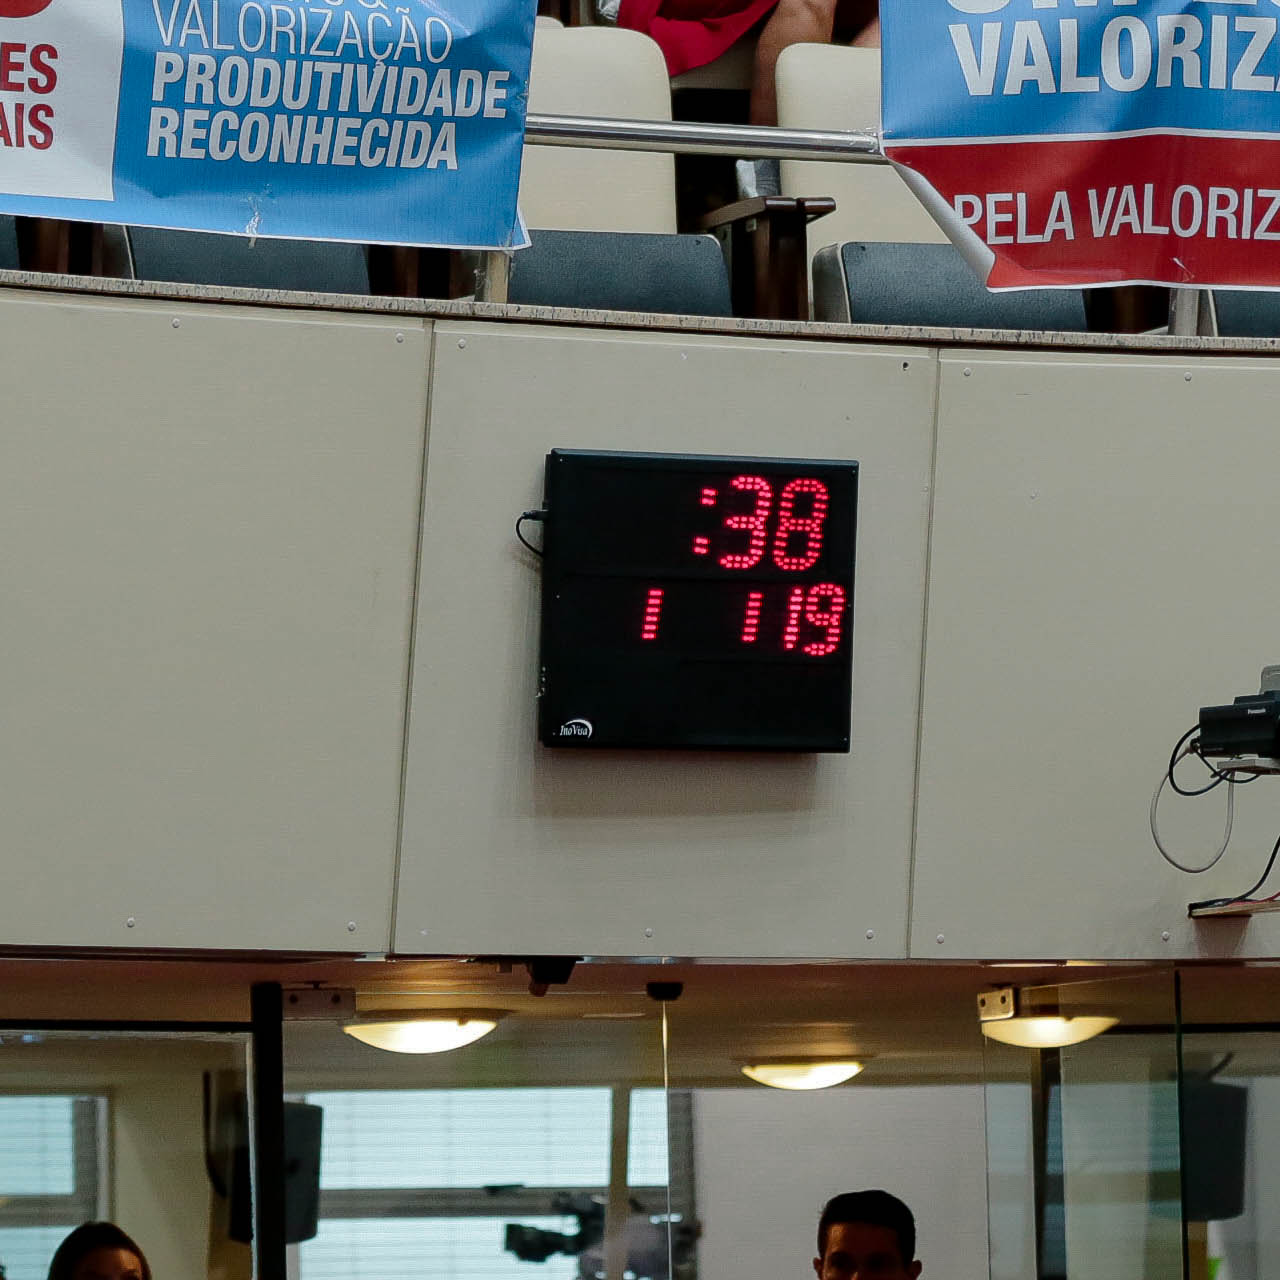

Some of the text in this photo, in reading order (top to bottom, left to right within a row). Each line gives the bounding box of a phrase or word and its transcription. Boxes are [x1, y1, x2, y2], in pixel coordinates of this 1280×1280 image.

[151, 52, 511, 119] PRODUTIVIDADE
[146, 107, 459, 171] RECONHECIDA
[953, 190, 1075, 245] PELA
